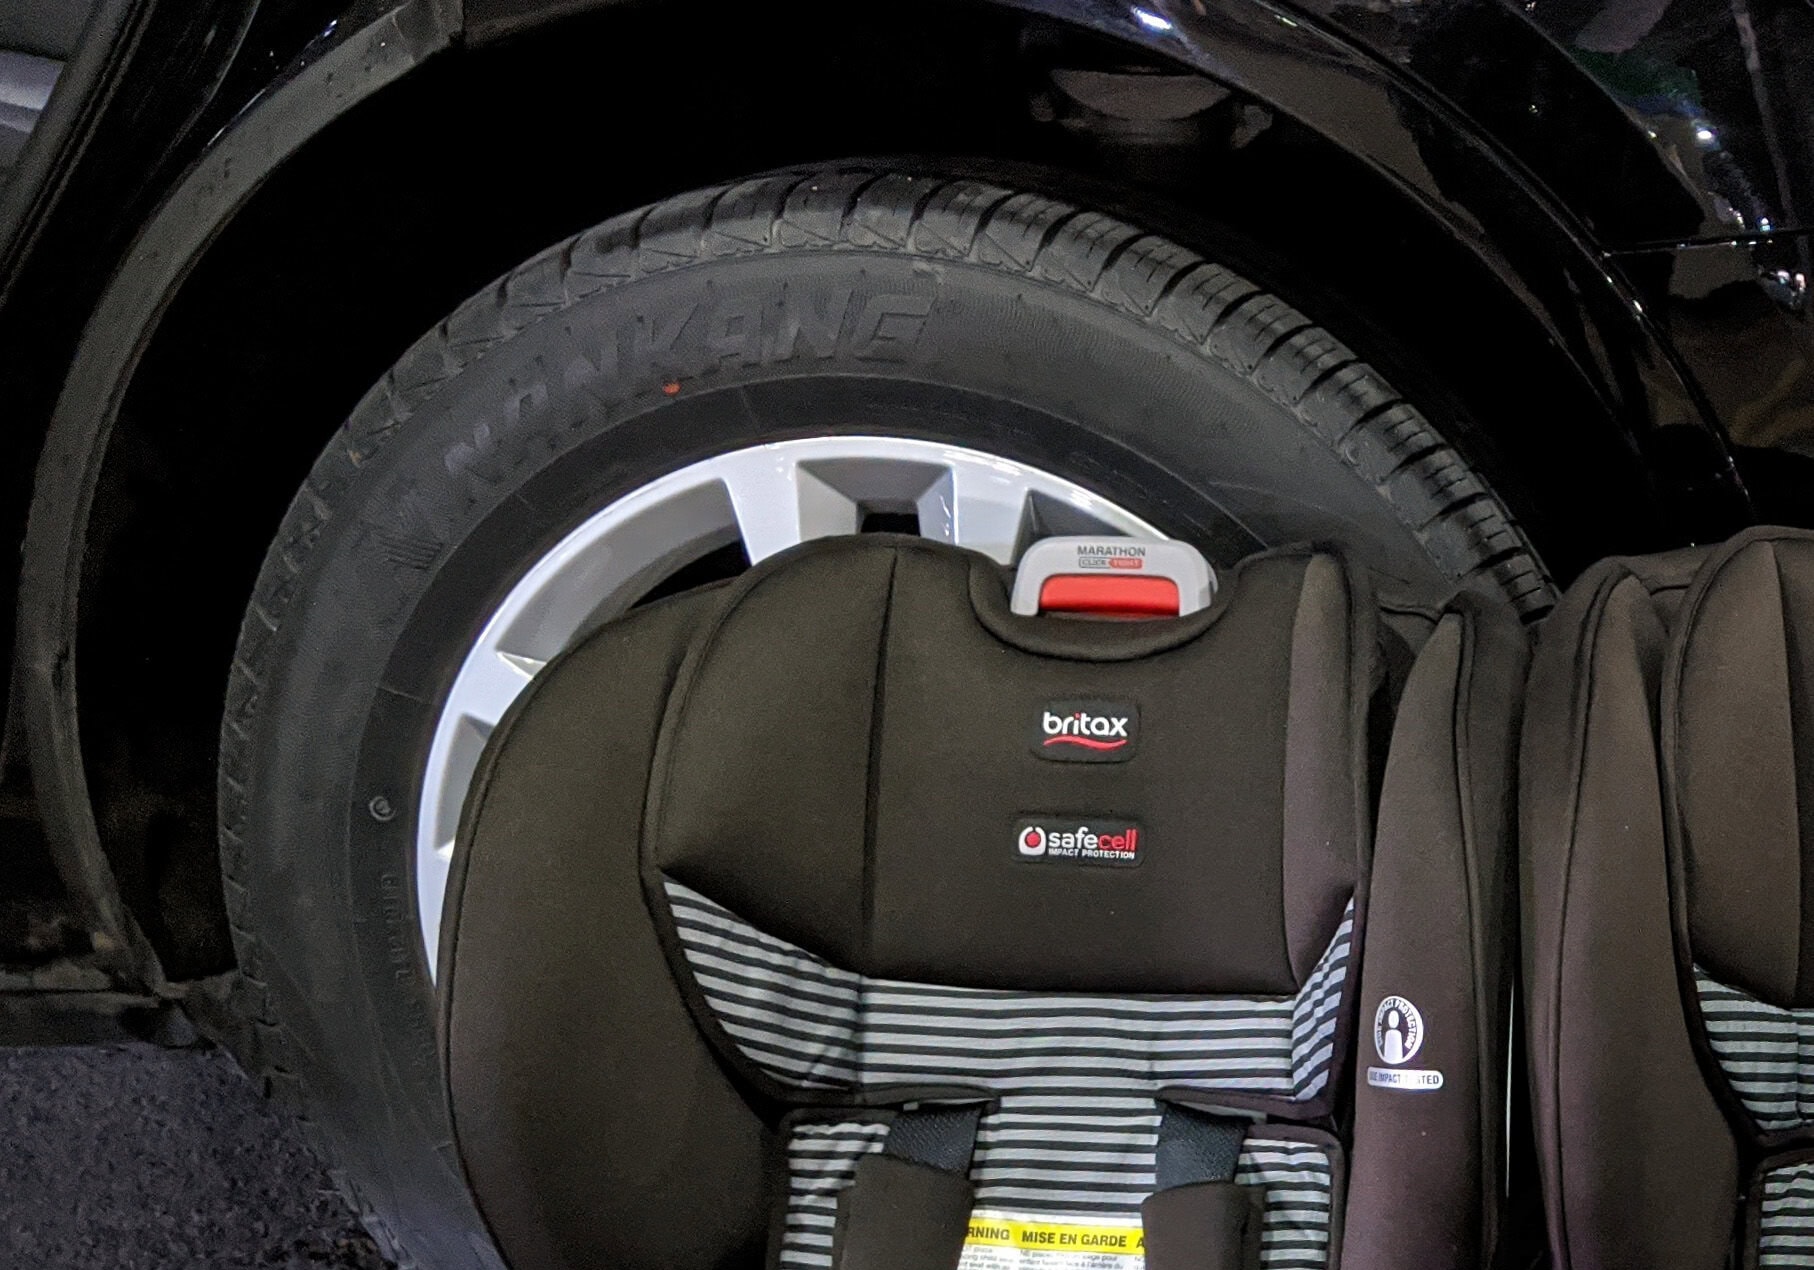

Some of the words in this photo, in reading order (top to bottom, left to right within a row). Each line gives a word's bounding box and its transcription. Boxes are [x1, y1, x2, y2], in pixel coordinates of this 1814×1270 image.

[1077, 545, 1146, 557] MARATHON
[1042, 711, 1129, 737] britax
[1048, 826, 1139, 852] safecell
[1048, 847, 1079, 857] IMPACT
[1081, 848, 1136, 860] PROTECTION
[1379, 1071, 1401, 1084] IMPACT
[966, 1225, 1010, 1241] RNING
[1021, 1230, 1055, 1245] MISE
[1059, 1233, 1077, 1246] EN
[1080, 1234, 1127, 1249] GARDE
